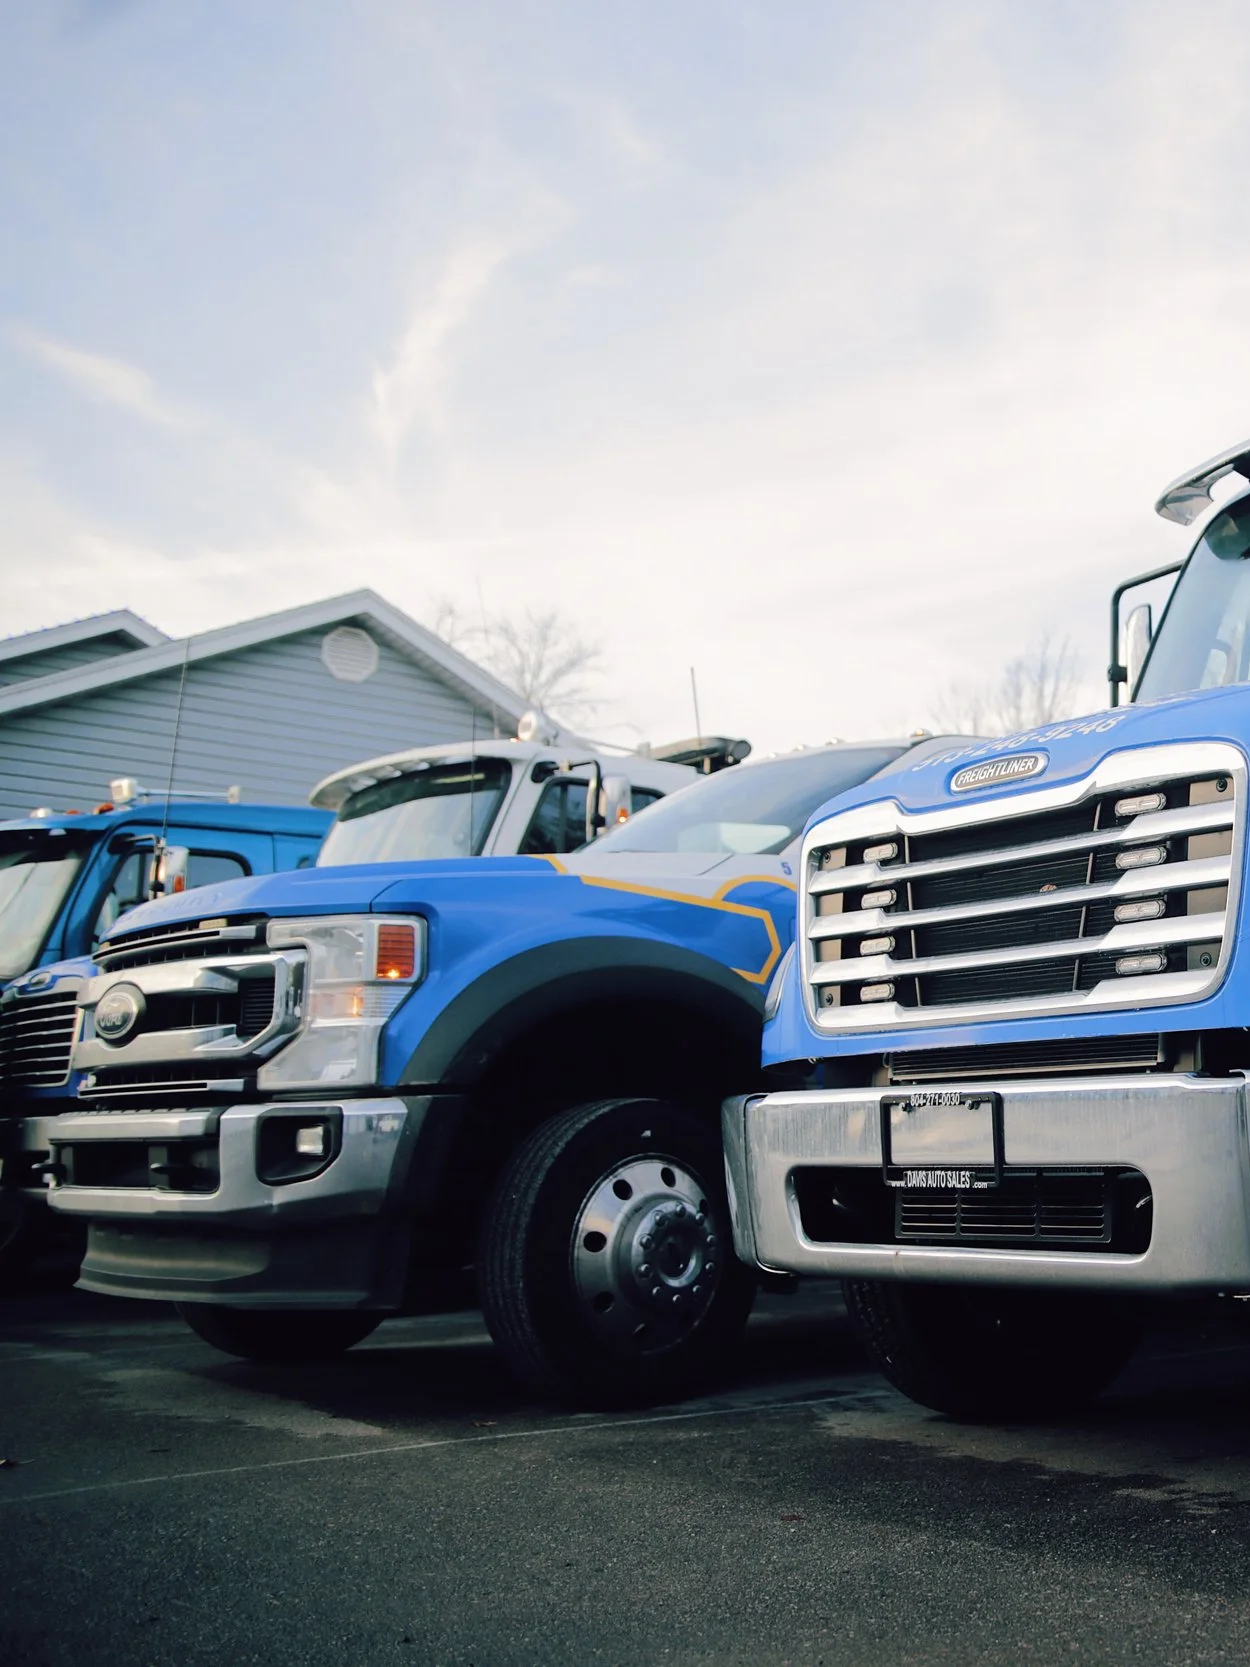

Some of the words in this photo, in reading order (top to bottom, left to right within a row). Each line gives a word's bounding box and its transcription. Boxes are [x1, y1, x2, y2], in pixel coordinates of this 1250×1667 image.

[957, 757, 1036, 785] FREIGHTLINER
[780, 861, 793, 876] 5
[910, 1092, 960, 1106] 804-271-0030
[907, 1170, 926, 1188] DAVIS
[927, 1170, 946, 1188] AUTO
[946, 1170, 970, 1189] SALES
